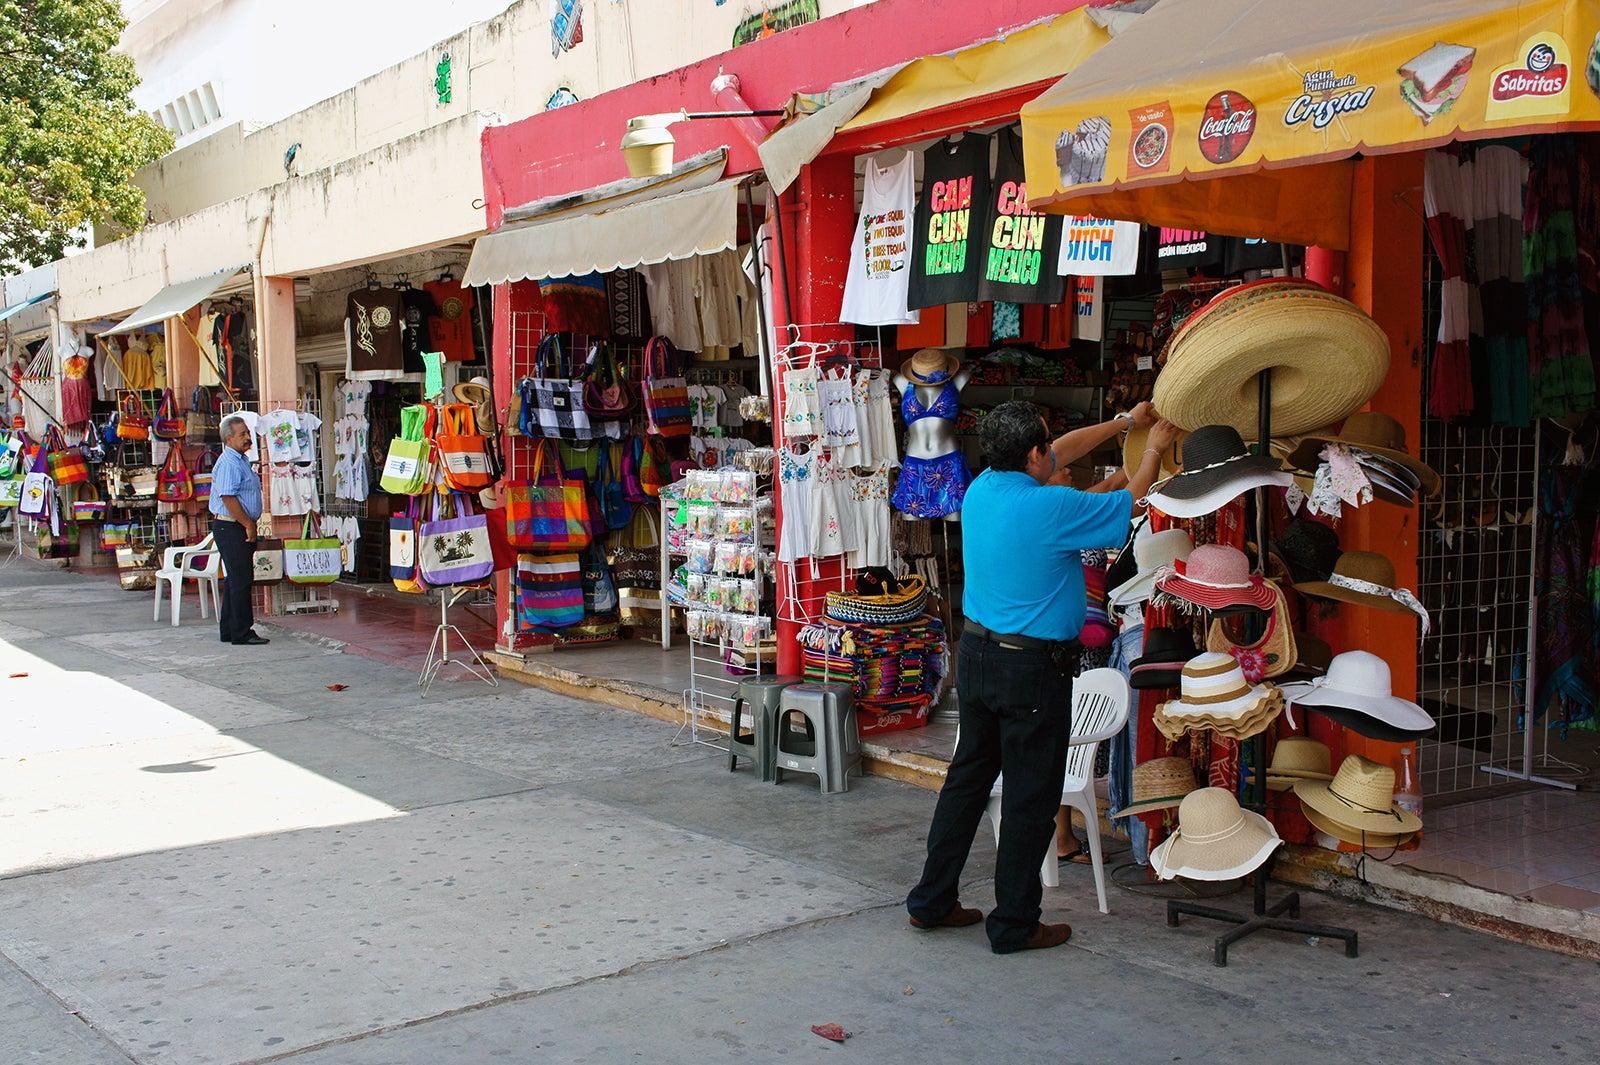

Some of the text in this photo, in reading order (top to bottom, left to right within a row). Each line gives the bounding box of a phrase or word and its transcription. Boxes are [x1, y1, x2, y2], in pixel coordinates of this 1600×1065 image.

[1304, 70, 1334, 83] Agua
[1304, 75, 1357, 93] Purificada
[1498, 74, 1563, 93] Sabritas
[1285, 86, 1376, 129] Cristal
[931, 175, 973, 213] CAN
[997, 181, 1047, 215] CA
[928, 208, 970, 244] CUN
[991, 215, 1046, 250] CUN
[926, 240, 967, 275] MEXICO
[1176, 241, 1207, 255] MÉXICO
[986, 247, 1042, 285] MEXICO
[296, 551, 330, 570] CANCUN
